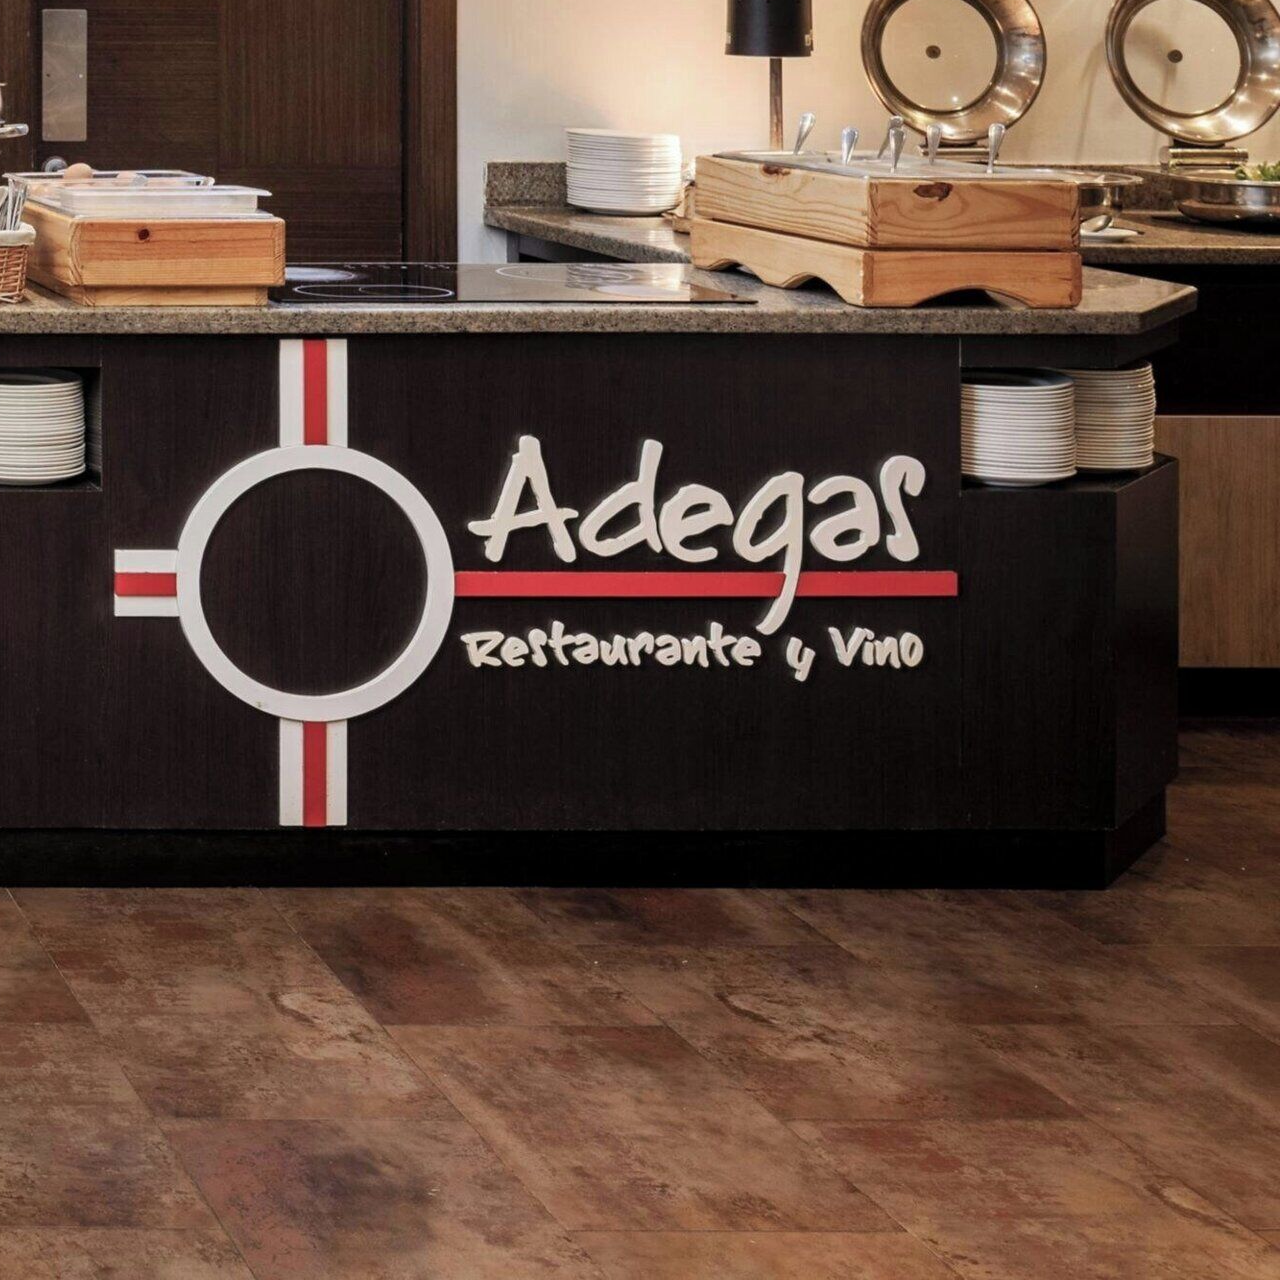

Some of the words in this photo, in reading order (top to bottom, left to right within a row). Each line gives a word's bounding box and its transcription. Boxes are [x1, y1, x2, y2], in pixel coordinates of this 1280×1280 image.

[467, 435, 926, 635] Adegas
[460, 621, 761, 667] Restaurante
[786, 637, 815, 682] y
[828, 625, 924, 669] Vino
